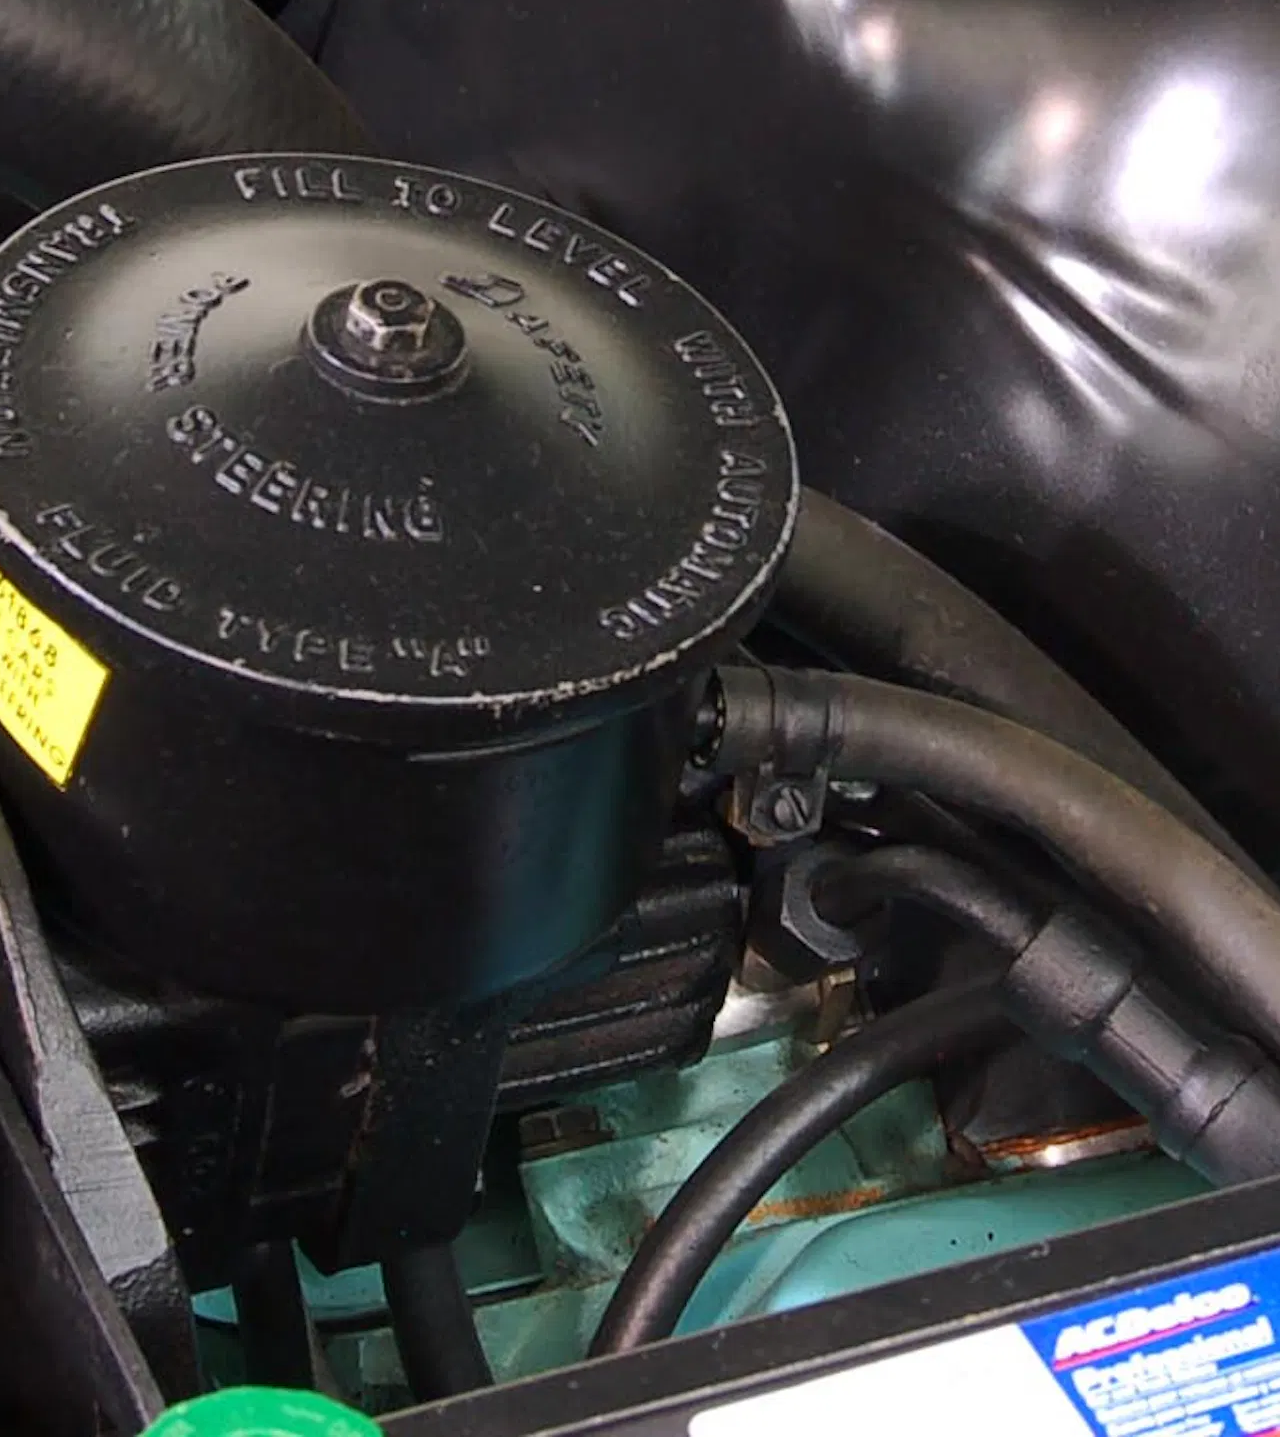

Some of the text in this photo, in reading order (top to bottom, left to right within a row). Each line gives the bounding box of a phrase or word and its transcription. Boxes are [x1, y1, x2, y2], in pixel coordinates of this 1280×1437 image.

[234, 167, 363, 201] FILL
[486, 202, 654, 309] LEVEL
[165, 403, 445, 542] STEERING
[598, 329, 768, 641] WITH AUTOMATIC
[35, 502, 182, 612] FLUID
[218, 606, 376, 673] TYPE
